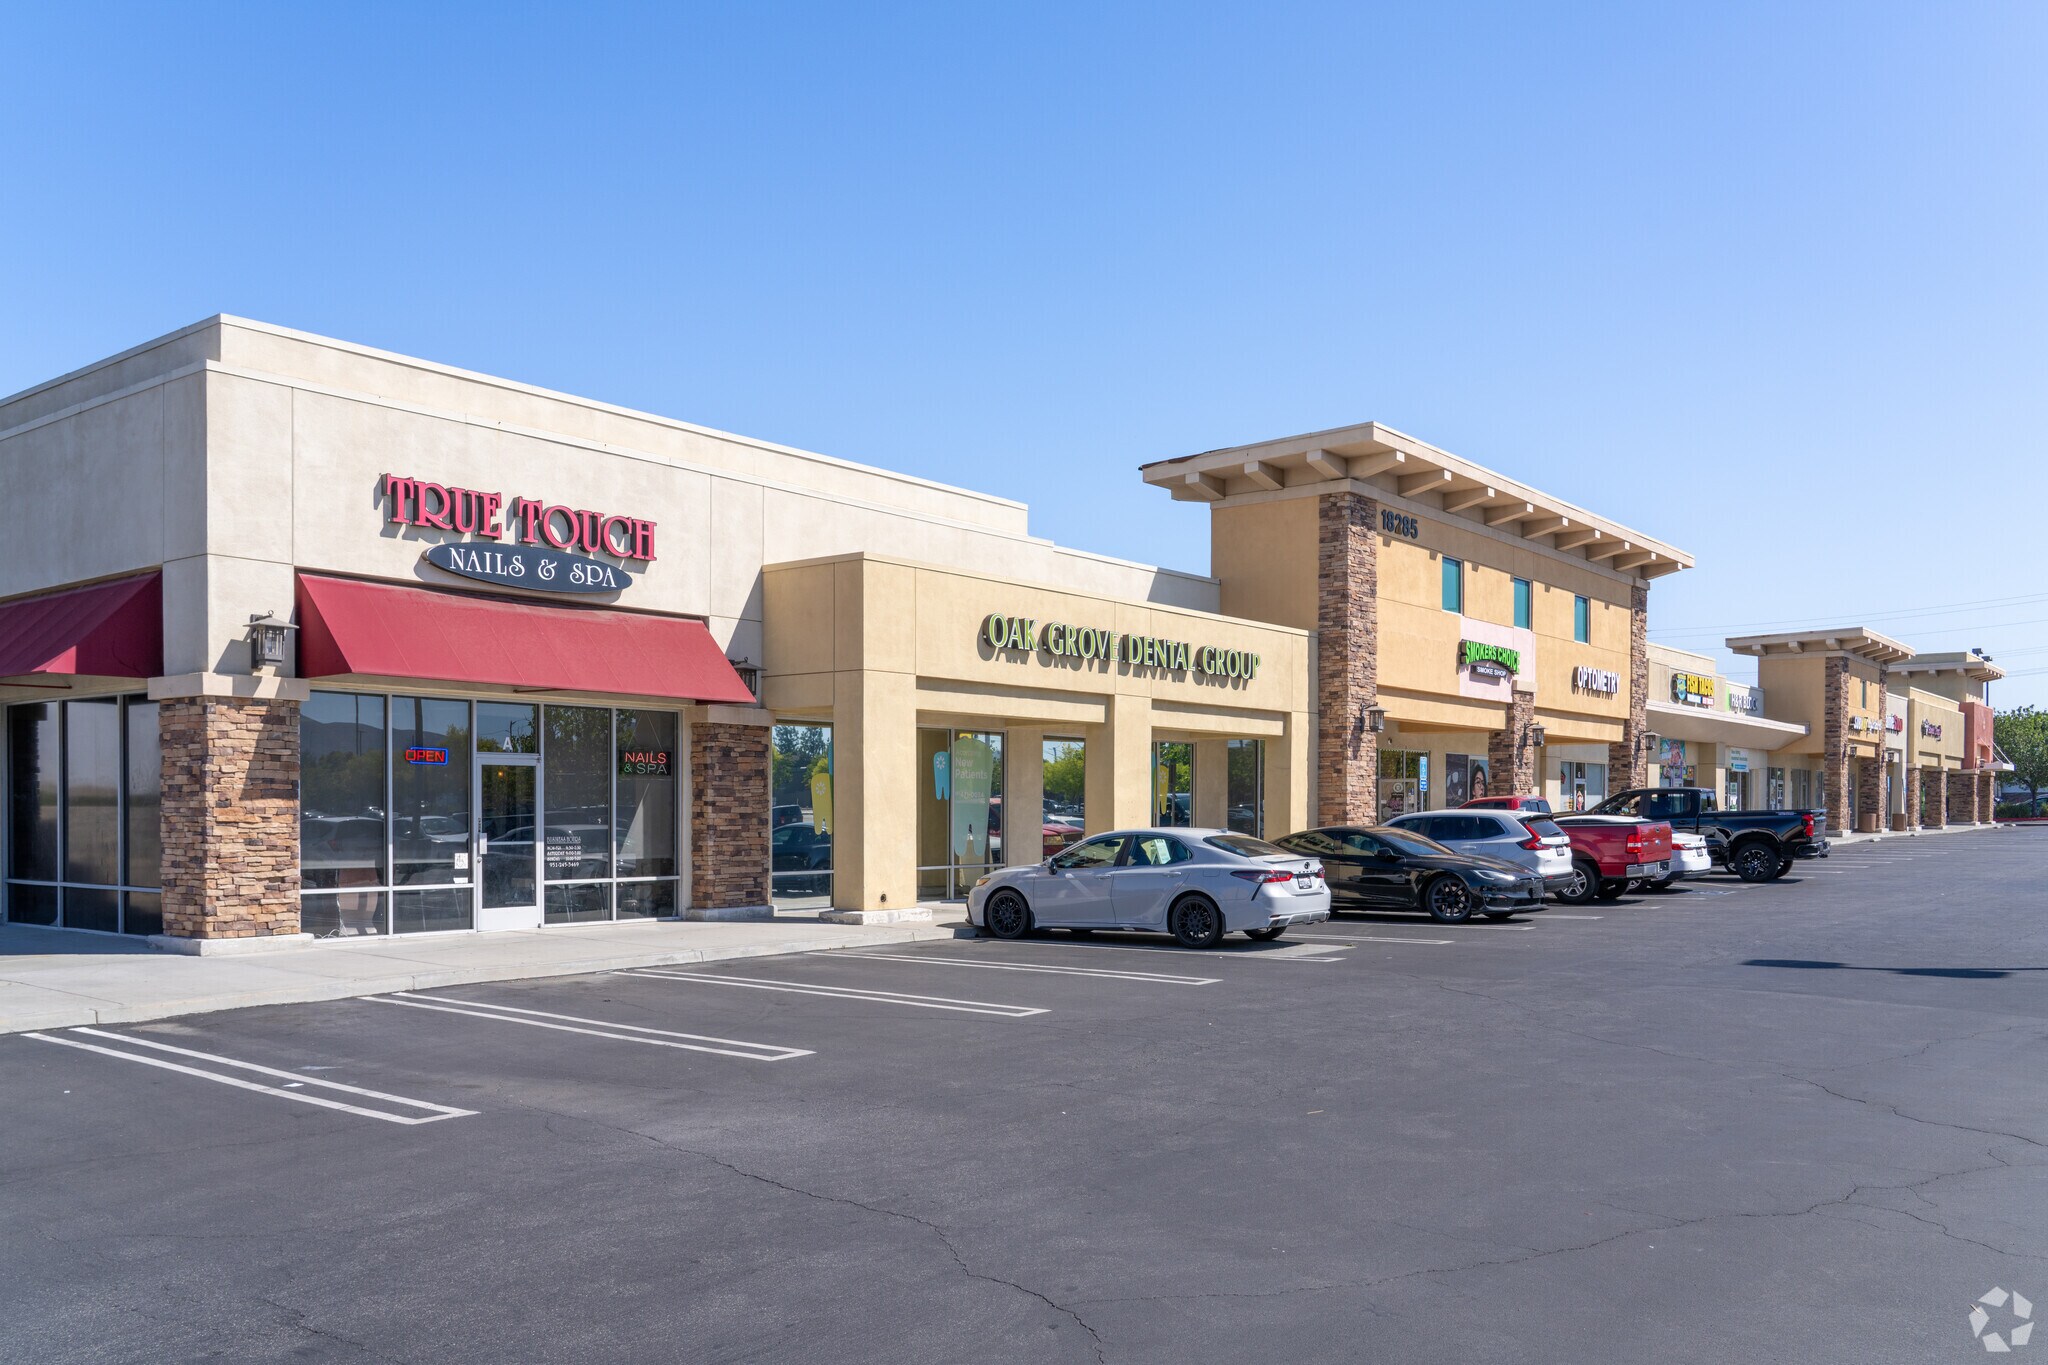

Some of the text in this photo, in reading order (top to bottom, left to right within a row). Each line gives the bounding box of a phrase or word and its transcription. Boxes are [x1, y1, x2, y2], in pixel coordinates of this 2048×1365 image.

[383, 473, 657, 561] TRUE TOUCH
[1381, 509, 1418, 539] 18285
[449, 547, 617, 588] NAILS & SPA
[988, 612, 1262, 680] OAK GROVE DENTAL GROUP
[1465, 640, 1520, 674] SMOKERS CHOICE
[1477, 666, 1507, 677] SMOKE SHOP
[1577, 665, 1621, 695] OPTOMETRY
[502, 736, 513, 752] A
[405, 749, 445, 762] OPEN
[624, 751, 667, 764] NAILS
[955, 757, 973, 767] New
[623, 762, 668, 775] & SPA
[955, 768, 987, 779] Patients
